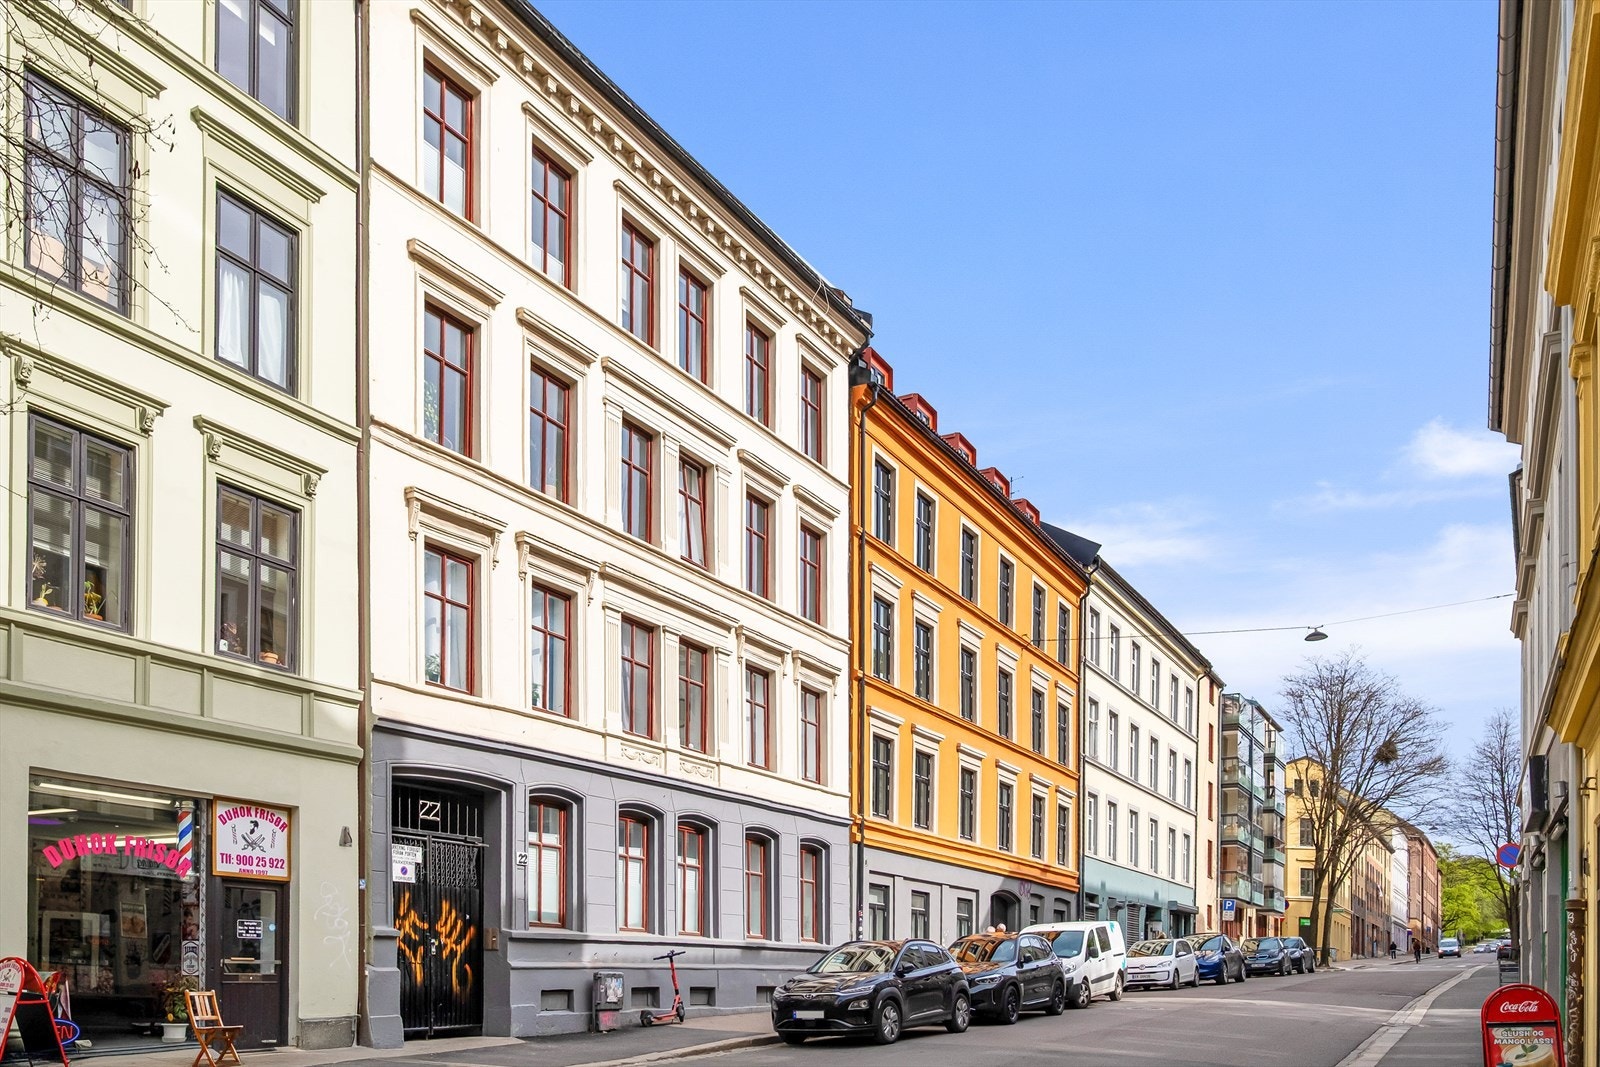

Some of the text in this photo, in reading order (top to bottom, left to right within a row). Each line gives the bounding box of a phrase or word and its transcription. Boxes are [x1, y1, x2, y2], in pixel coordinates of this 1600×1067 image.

[420, 800, 440, 821] 22
[218, 806, 288, 832] DUHOK FRISØR
[43, 833, 192, 878] DUHOK FRISØR
[220, 853, 284, 869] Tlf: 900 25 922
[518, 853, 528, 864] 22
[1500, 1000, 1540, 1013] Coca-Cola
[1527, 1037, 1554, 1045] LASSI
